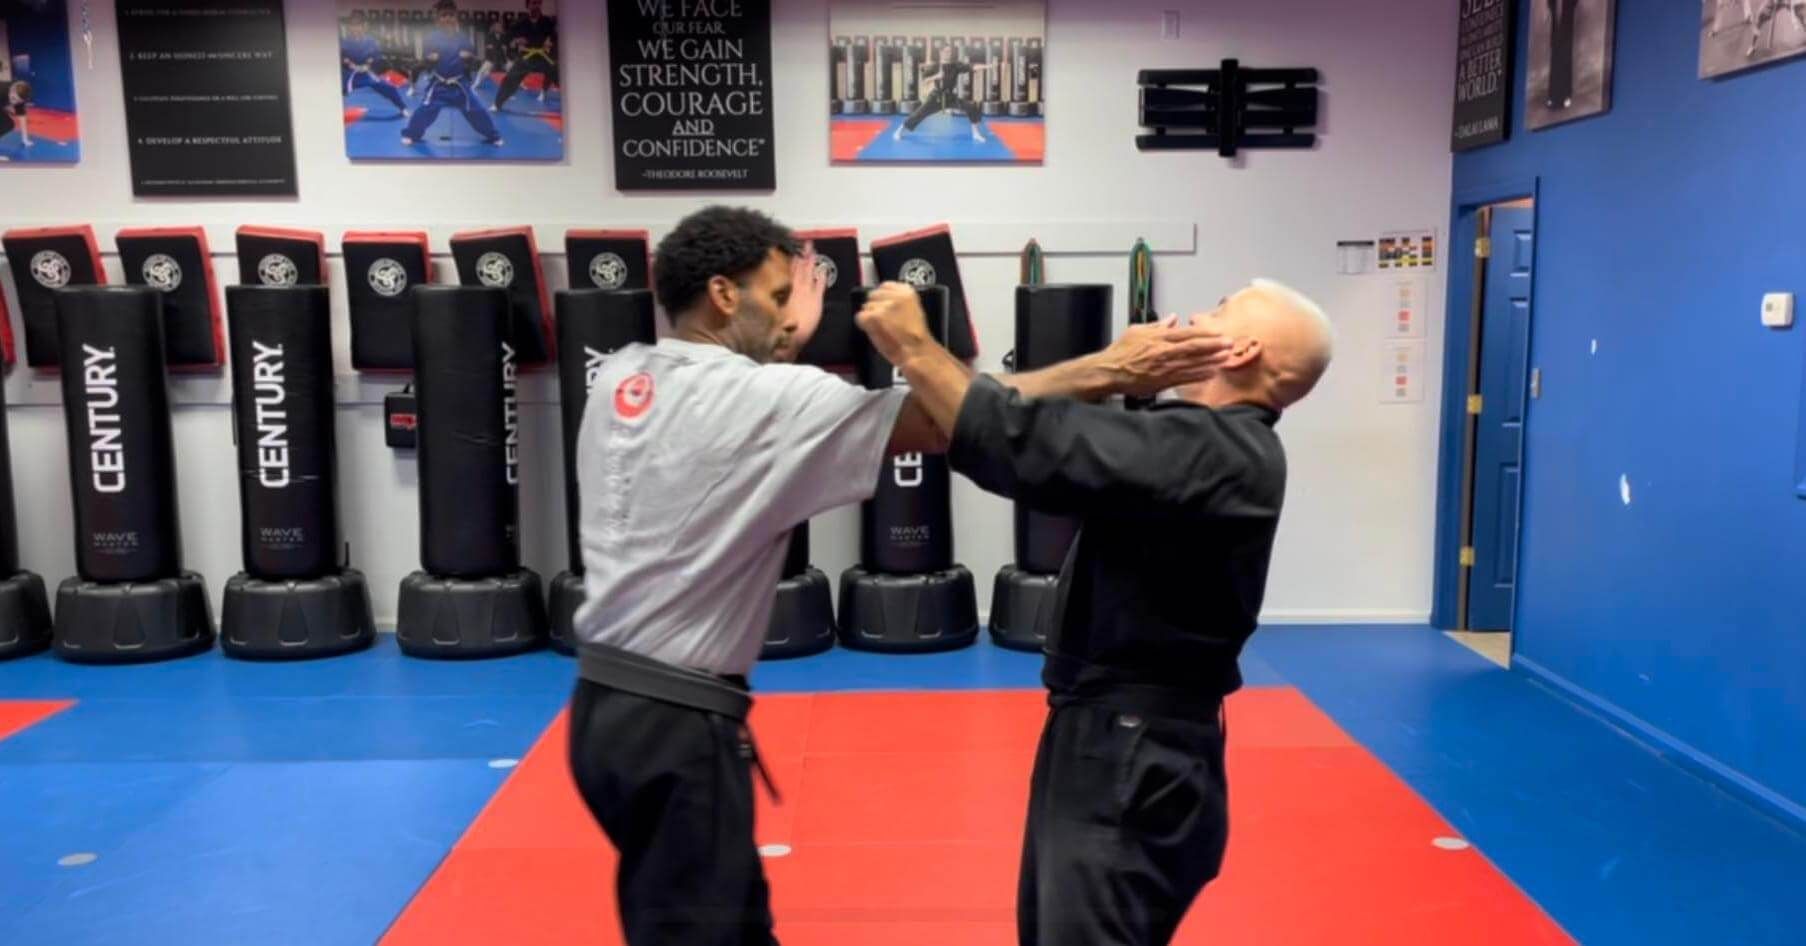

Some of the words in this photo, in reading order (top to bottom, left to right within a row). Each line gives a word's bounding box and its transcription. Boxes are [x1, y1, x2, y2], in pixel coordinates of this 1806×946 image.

[639, 0, 674, 17] WE
[681, 0, 743, 17] FACE
[652, 21, 686, 34] OUR
[638, 38, 675, 59] WE
[680, 38, 744, 60] GAIN
[620, 91, 763, 117] COURAGE
[671, 119, 716, 136] AND
[145, 137, 183, 146] DEVELOP
[192, 136, 241, 145] RESPECTFUL
[697, 169, 750, 179] ROOSEVELT
[260, 527, 303, 536] WAVE
[889, 525, 929, 534] WAVE
[93, 532, 138, 541] WAVE
